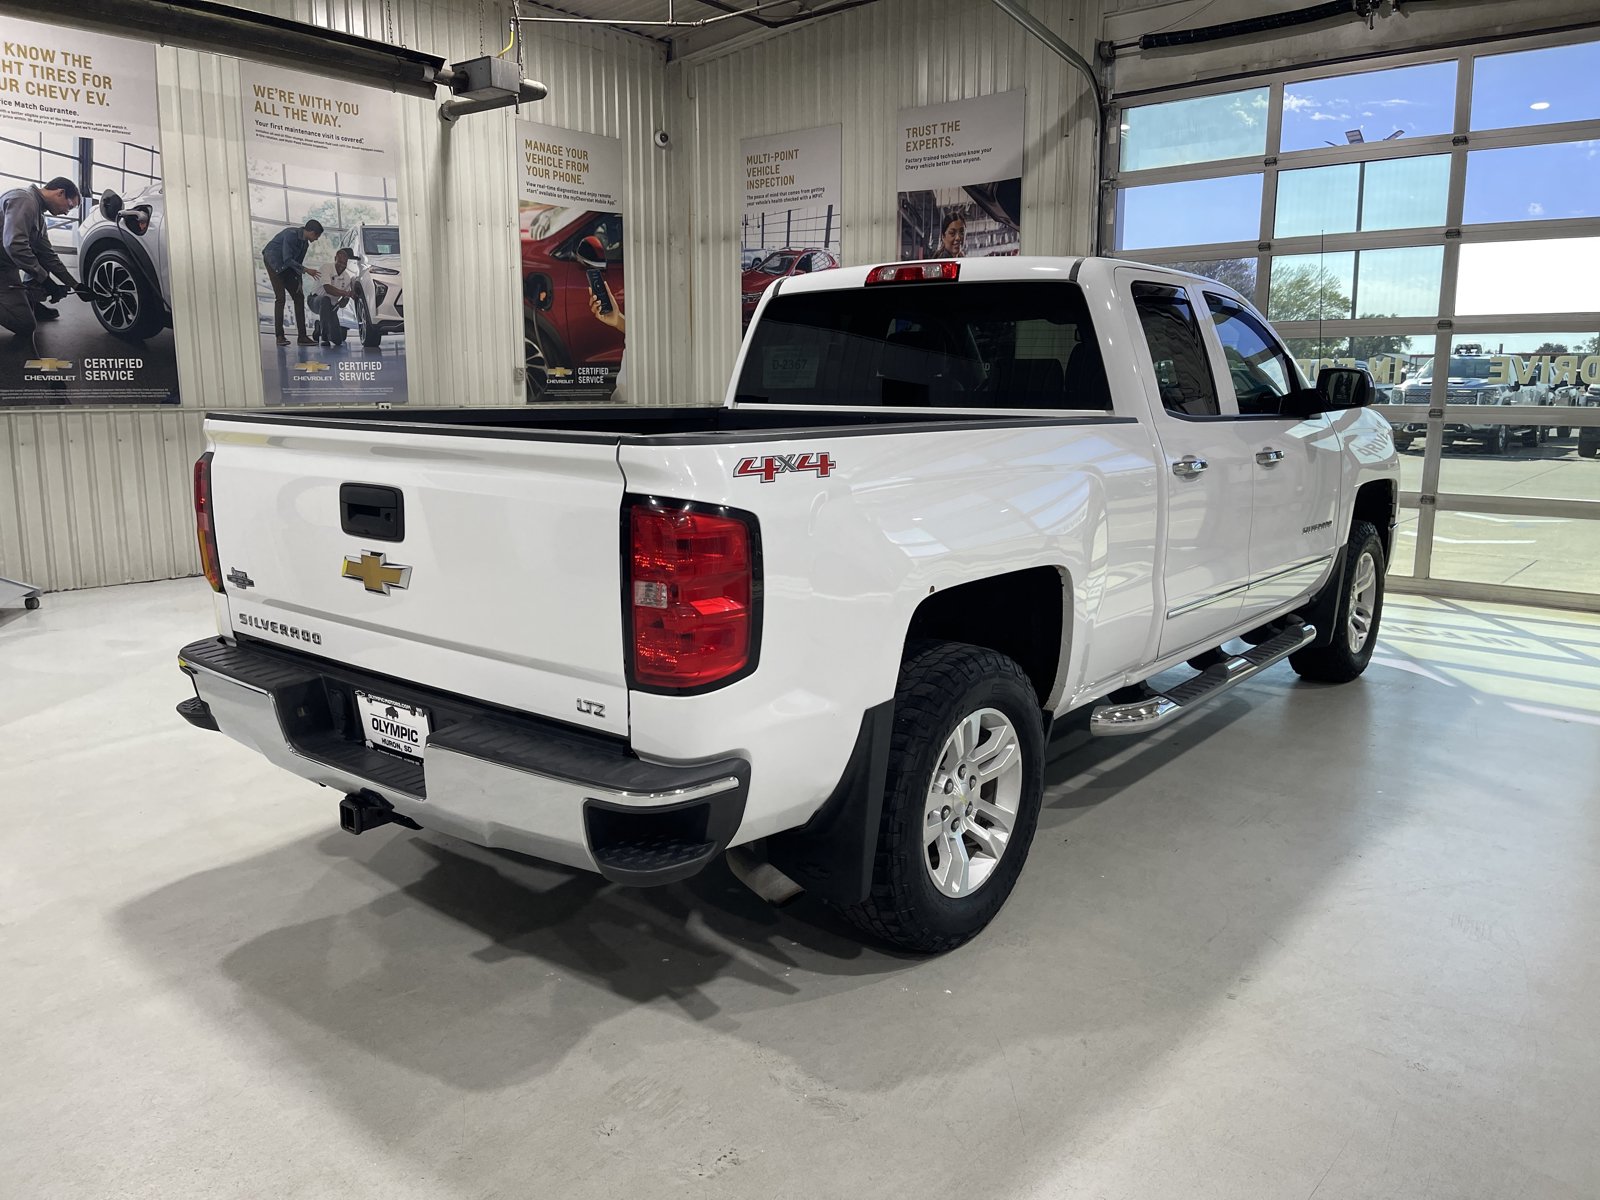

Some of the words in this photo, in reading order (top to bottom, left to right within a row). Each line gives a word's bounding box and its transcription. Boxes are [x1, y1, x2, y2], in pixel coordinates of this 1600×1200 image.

[4, 41, 56, 63] KNOW
[61, 52, 93, 69] THE
[29, 64, 77, 84] TIRES
[82, 73, 112, 90] FOR
[25, 81, 80, 102] CHEVY
[86, 91, 110, 106] EV.
[253, 84, 295, 104] WE'RE
[299, 94, 332, 111] WITH
[335, 100, 359, 115] YOU
[14, 101, 38, 111] Match
[39, 104, 80, 117] Guarantee.
[254, 101, 279, 117] ALL
[283, 106, 308, 122] THE
[311, 111, 341, 128] WAY.
[255, 120, 269, 128] Your
[270, 122, 283, 131] first
[284, 126, 321, 137] maintenance
[322, 132, 334, 140] visit
[906, 124, 938, 139] TRUST
[940, 120, 960, 134] THE
[525, 139, 563, 156] MANAGE
[565, 147, 588, 160] YOUR
[906, 136, 954, 152] EXPERTS.
[746, 149, 799, 166] MULTI-POINT
[940, 152, 967, 160] technicians
[981, 147, 992, 155] your
[525, 152, 563, 169] VEHICLE
[565, 160, 589, 173] FROM
[746, 164, 780, 178] VEHICLE
[526, 165, 550, 179] YOUR
[553, 170, 584, 185] PHONE.
[747, 175, 795, 190] INSPECTION
[557, 185, 579, 195] diagnostics
[84, 358, 143, 369] CERTIFIED
[338, 361, 382, 370] CERTIFIED
[578, 367, 609, 375] CERTIFIED
[85, 370, 134, 381] SERVICE
[339, 372, 376, 381] SERVICE
[578, 376, 604, 384] SERVICE
[239, 613, 322, 645] SILVERADO
[576, 698, 605, 718] LTZ
[372, 718, 418, 743] OLYMPIC
[382, 738, 402, 751] HURON,
[404, 745, 412, 753] SD
